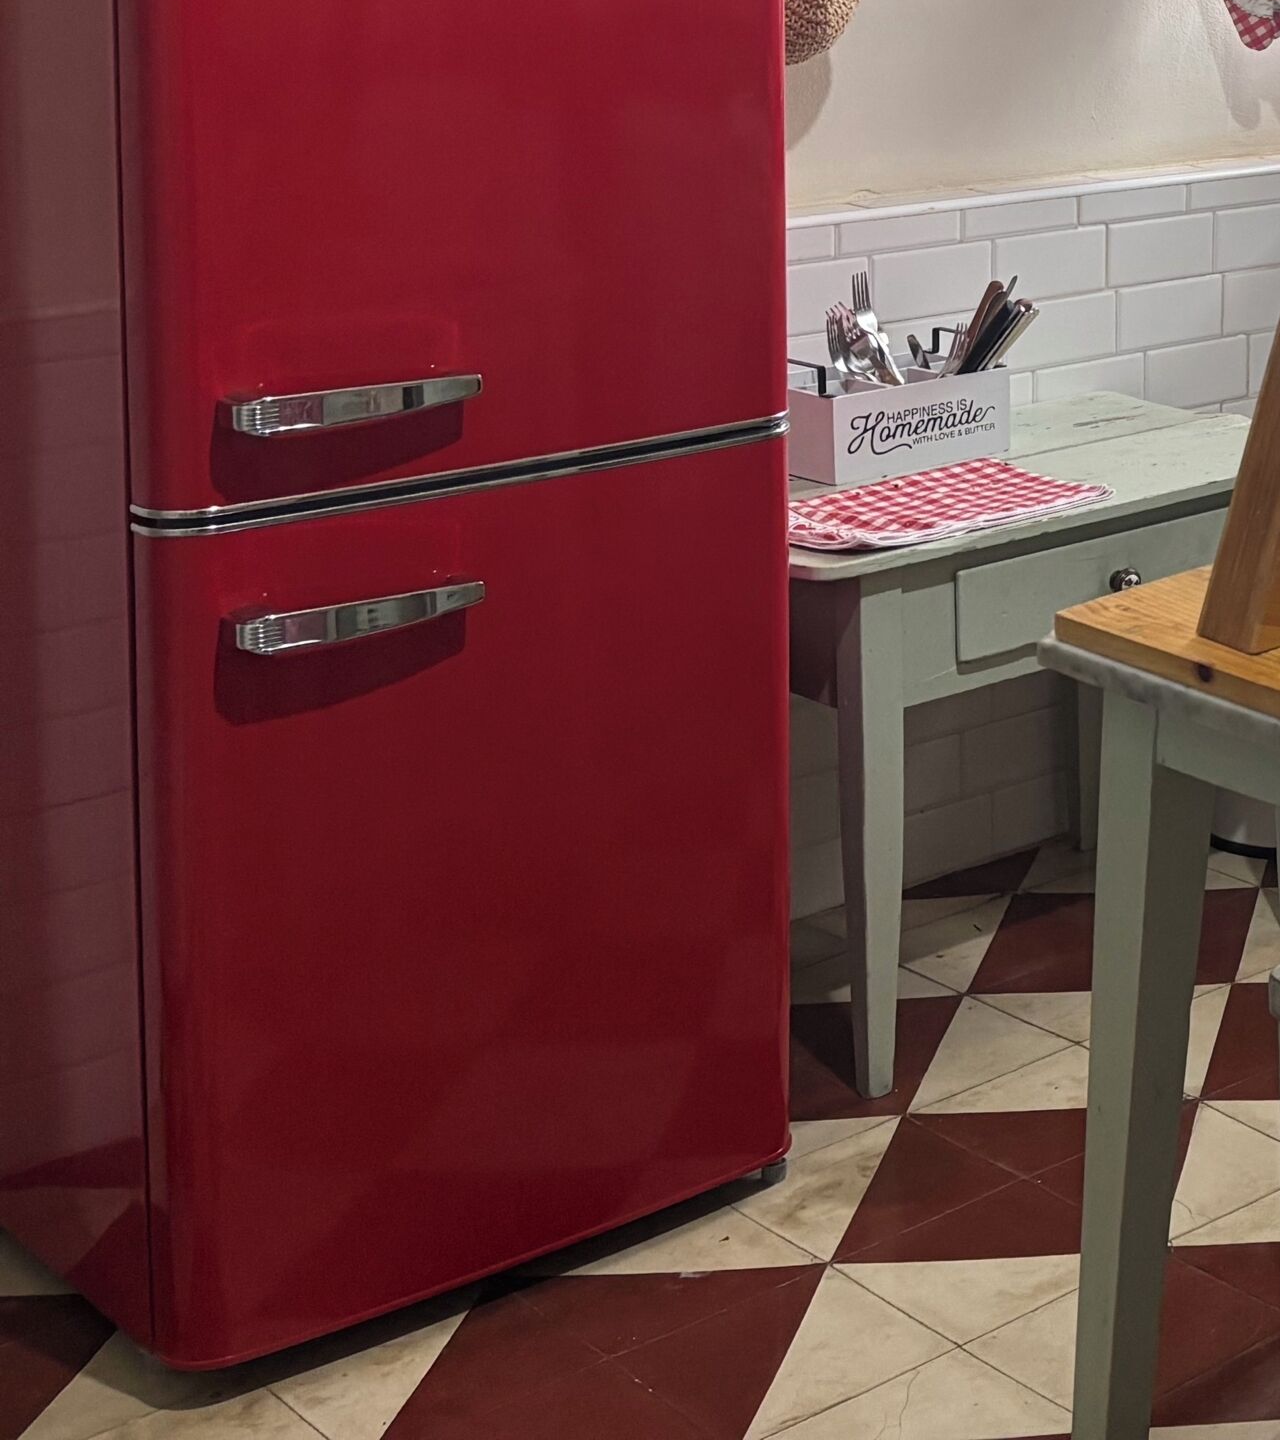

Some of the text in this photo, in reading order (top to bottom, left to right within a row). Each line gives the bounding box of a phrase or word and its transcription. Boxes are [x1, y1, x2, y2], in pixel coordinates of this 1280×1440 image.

[886, 398, 968, 425] HAPPINESS IS
[847, 399, 996, 456] Homemade
[912, 422, 996, 446] WITH LOVE & BUTTER
